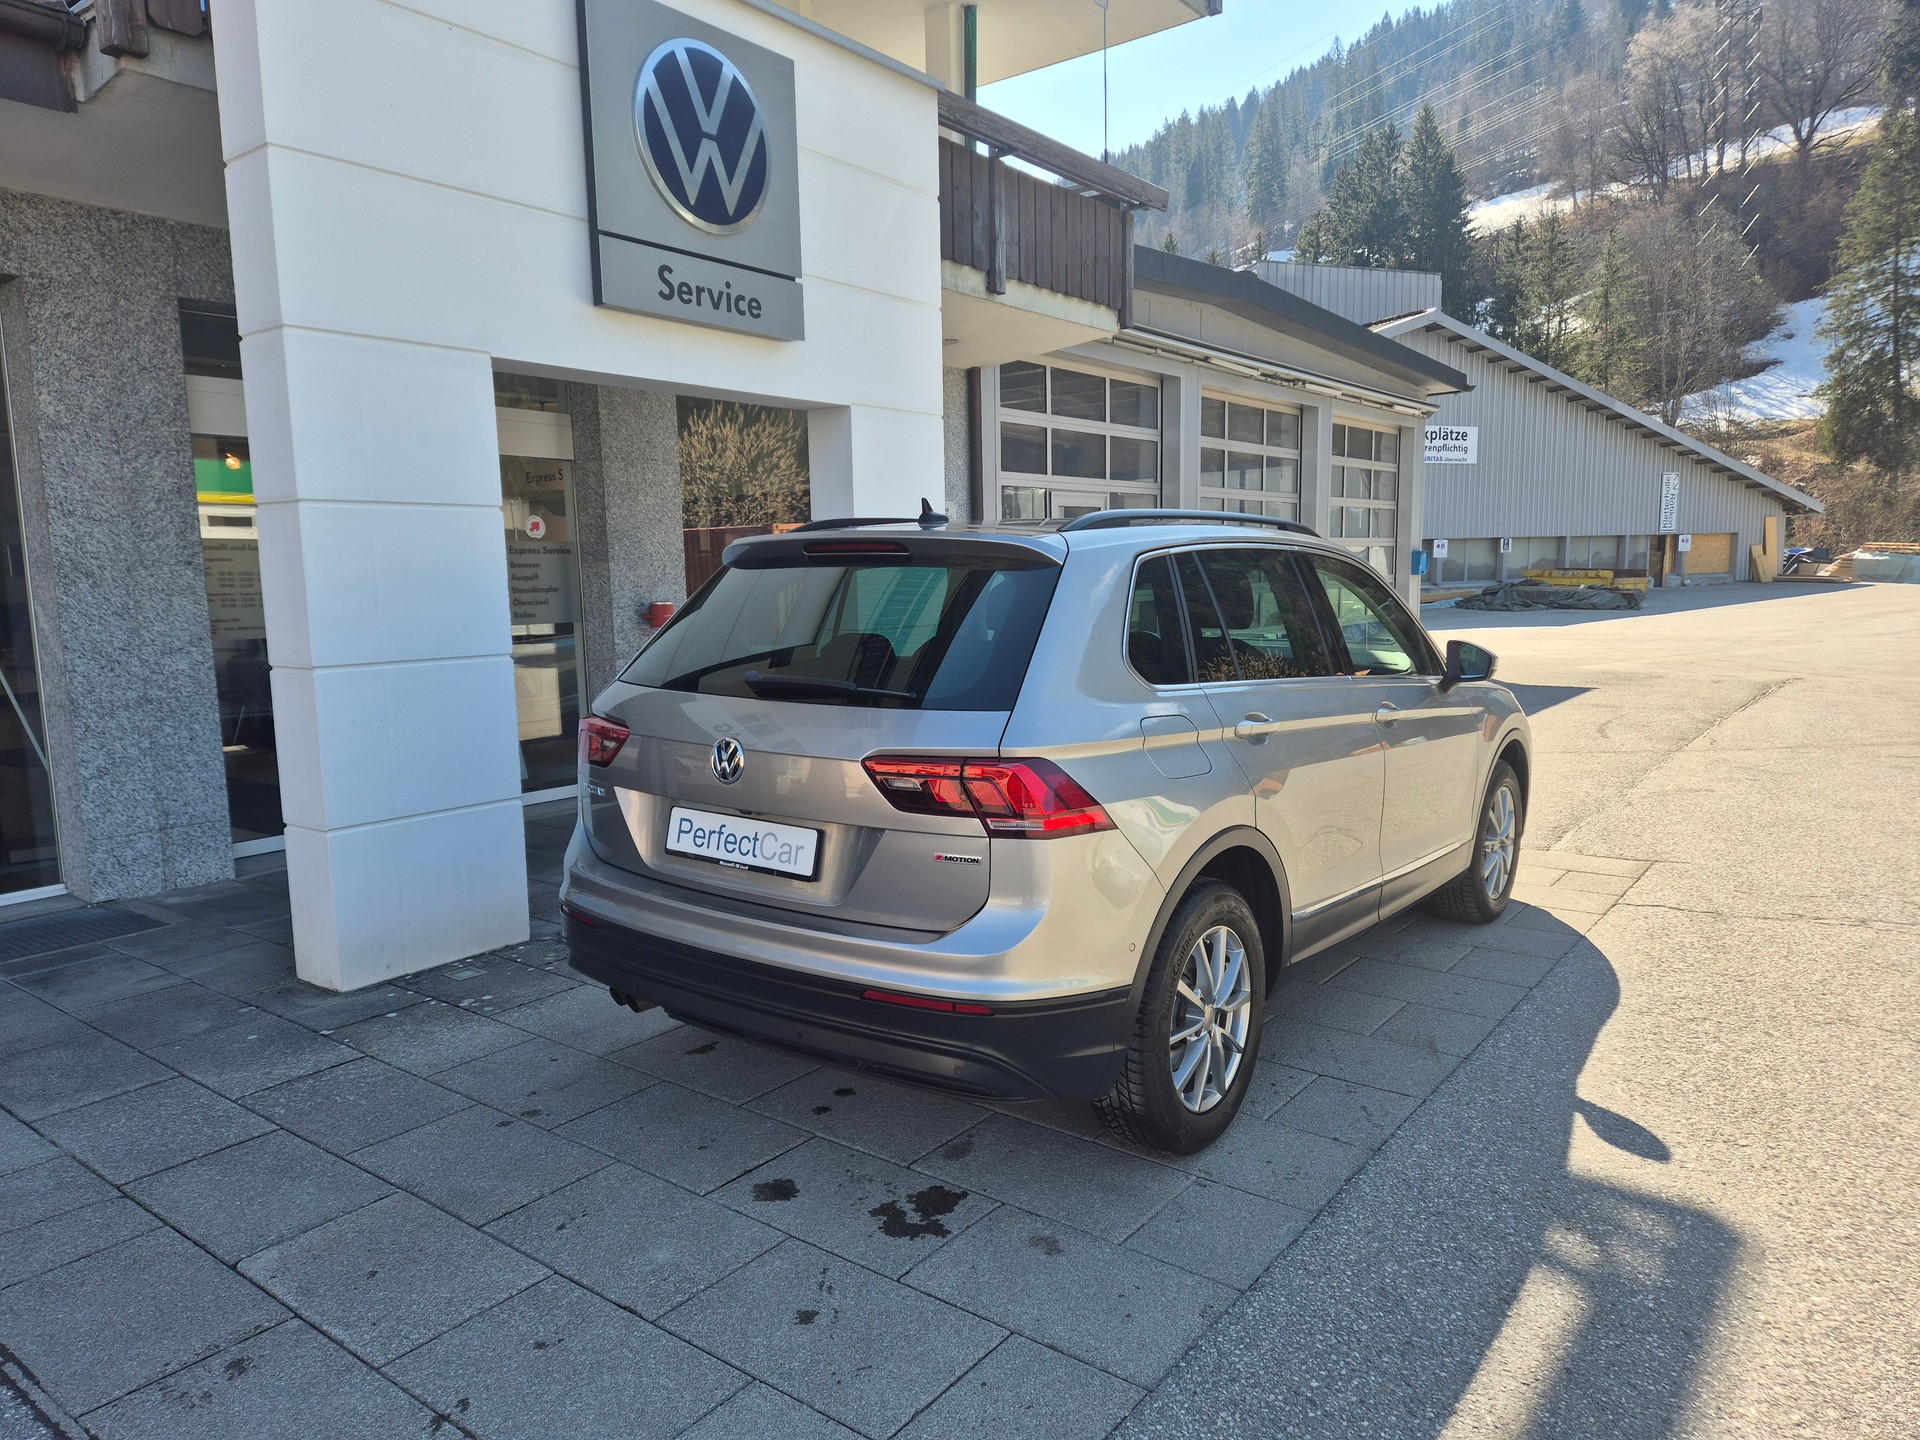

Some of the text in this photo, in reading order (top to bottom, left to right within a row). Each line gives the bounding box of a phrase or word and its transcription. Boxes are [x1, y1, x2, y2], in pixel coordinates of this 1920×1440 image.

[657, 264, 762, 319] Service
[1425, 443, 1468, 454] renpflichtig
[525, 471, 556, 484] Express
[508, 546, 571, 556] Express Service
[510, 561, 540, 569] Bremsen
[511, 573, 539, 582] Auspuff
[511, 585, 559, 594] Stossdämpfer
[513, 611, 536, 619] Reifen
[676, 817, 805, 866] PerfectCar
